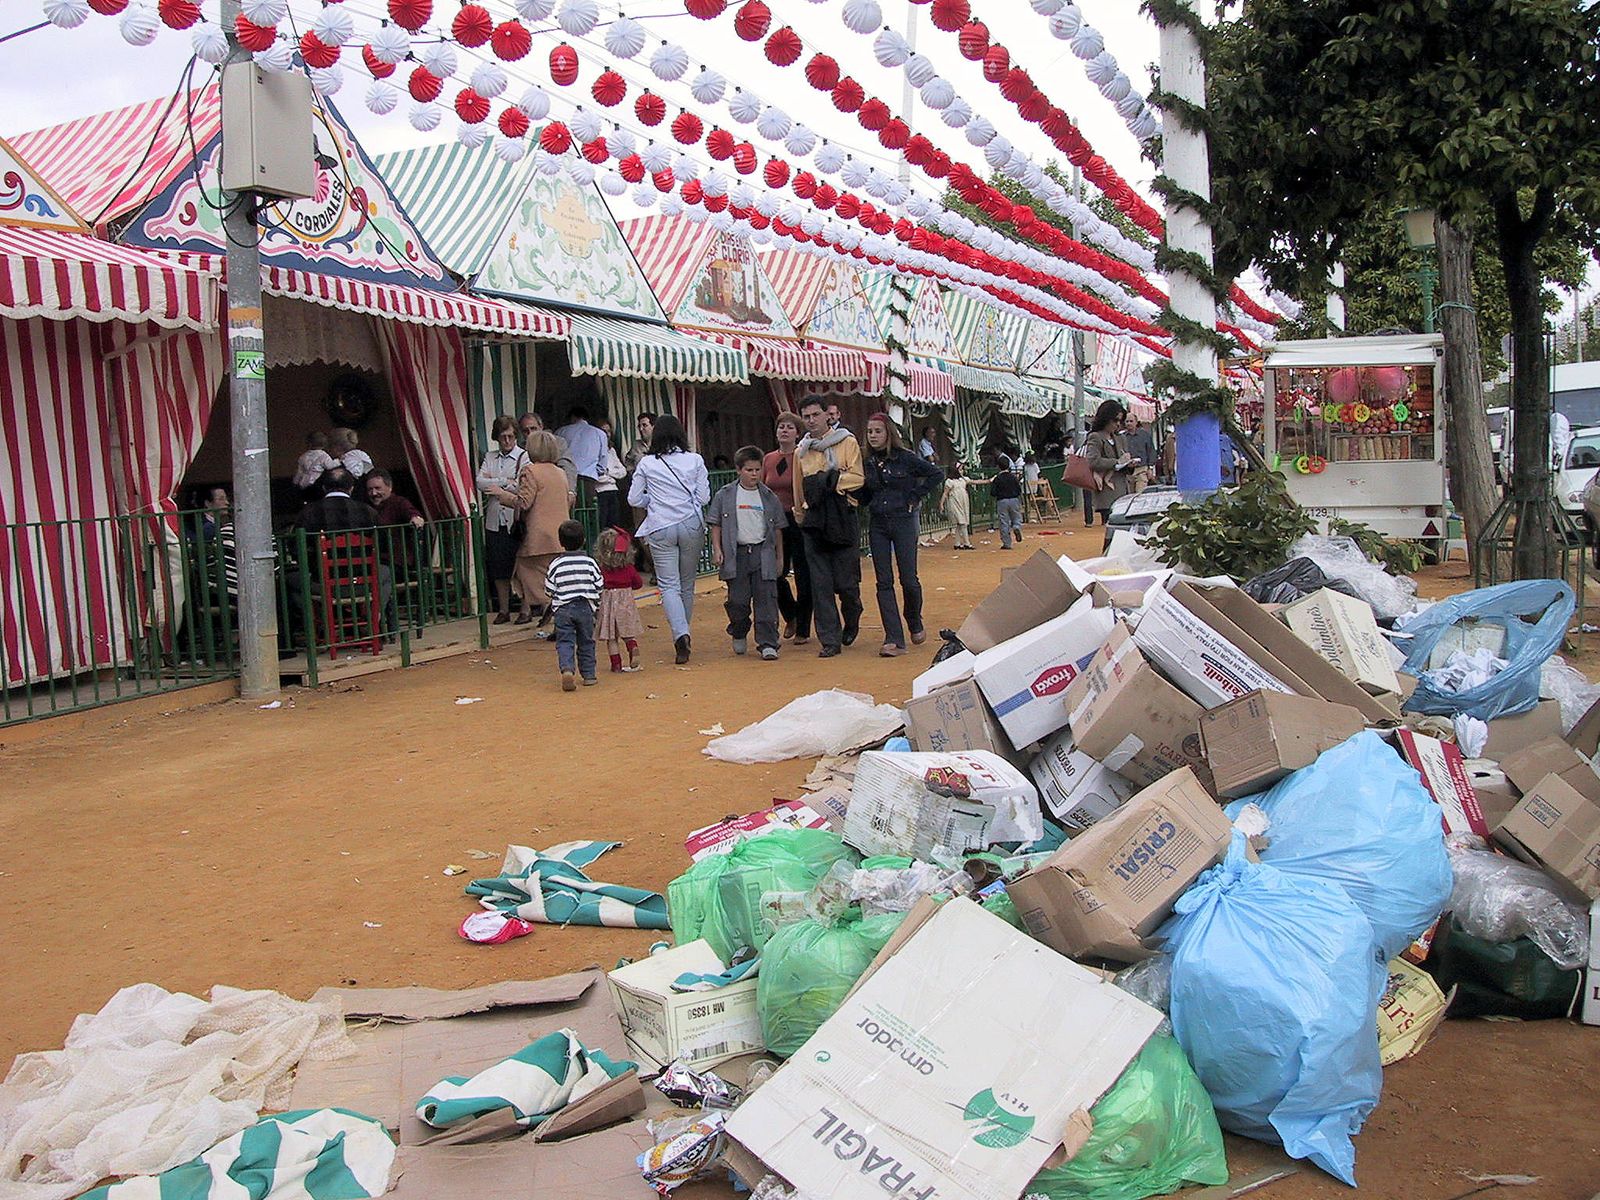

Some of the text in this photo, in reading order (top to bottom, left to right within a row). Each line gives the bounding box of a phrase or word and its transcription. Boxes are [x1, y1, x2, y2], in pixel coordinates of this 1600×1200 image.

[295, 180, 343, 233] CORDIALES
[720, 245, 751, 264] GLORIA
[1035, 667, 1074, 694] froxá
[1200, 664, 1244, 699] eiballi
[1114, 821, 1177, 882] CRISAL
[711, 1001, 725, 1014] MH
[855, 1016, 934, 1077] amador
